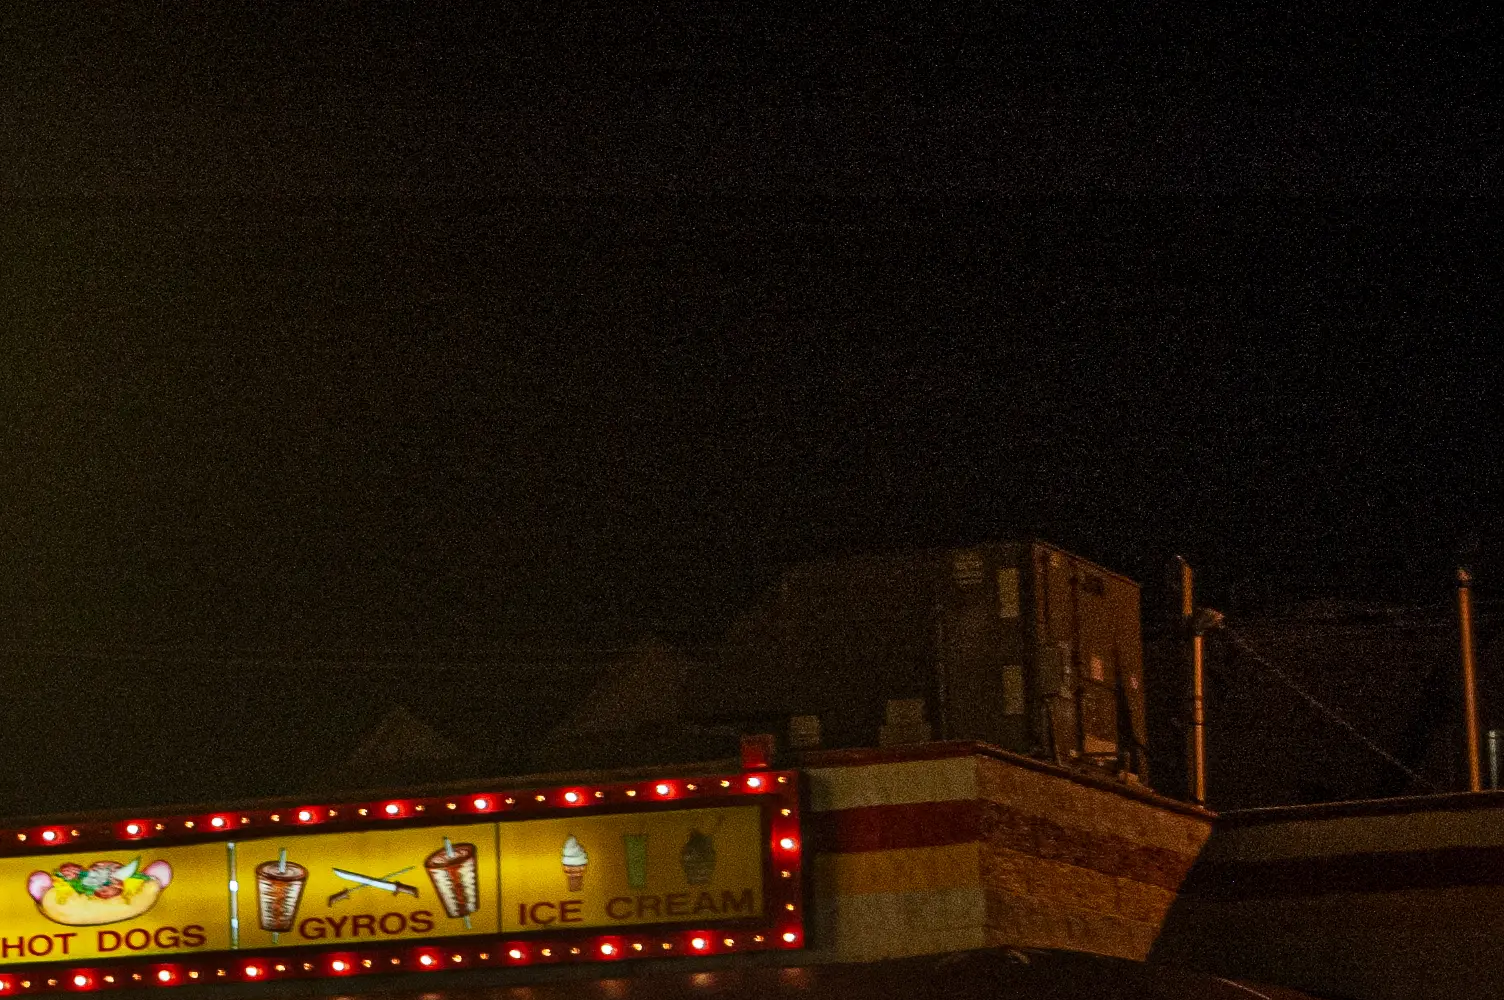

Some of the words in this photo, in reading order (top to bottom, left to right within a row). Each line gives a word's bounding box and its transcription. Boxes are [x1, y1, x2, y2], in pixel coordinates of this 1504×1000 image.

[518, 899, 582, 927] ICE
[605, 887, 755, 922] CREAM
[1, 932, 77, 959] HOT
[97, 925, 207, 952] DOGS
[299, 910, 435, 941] GYROS
